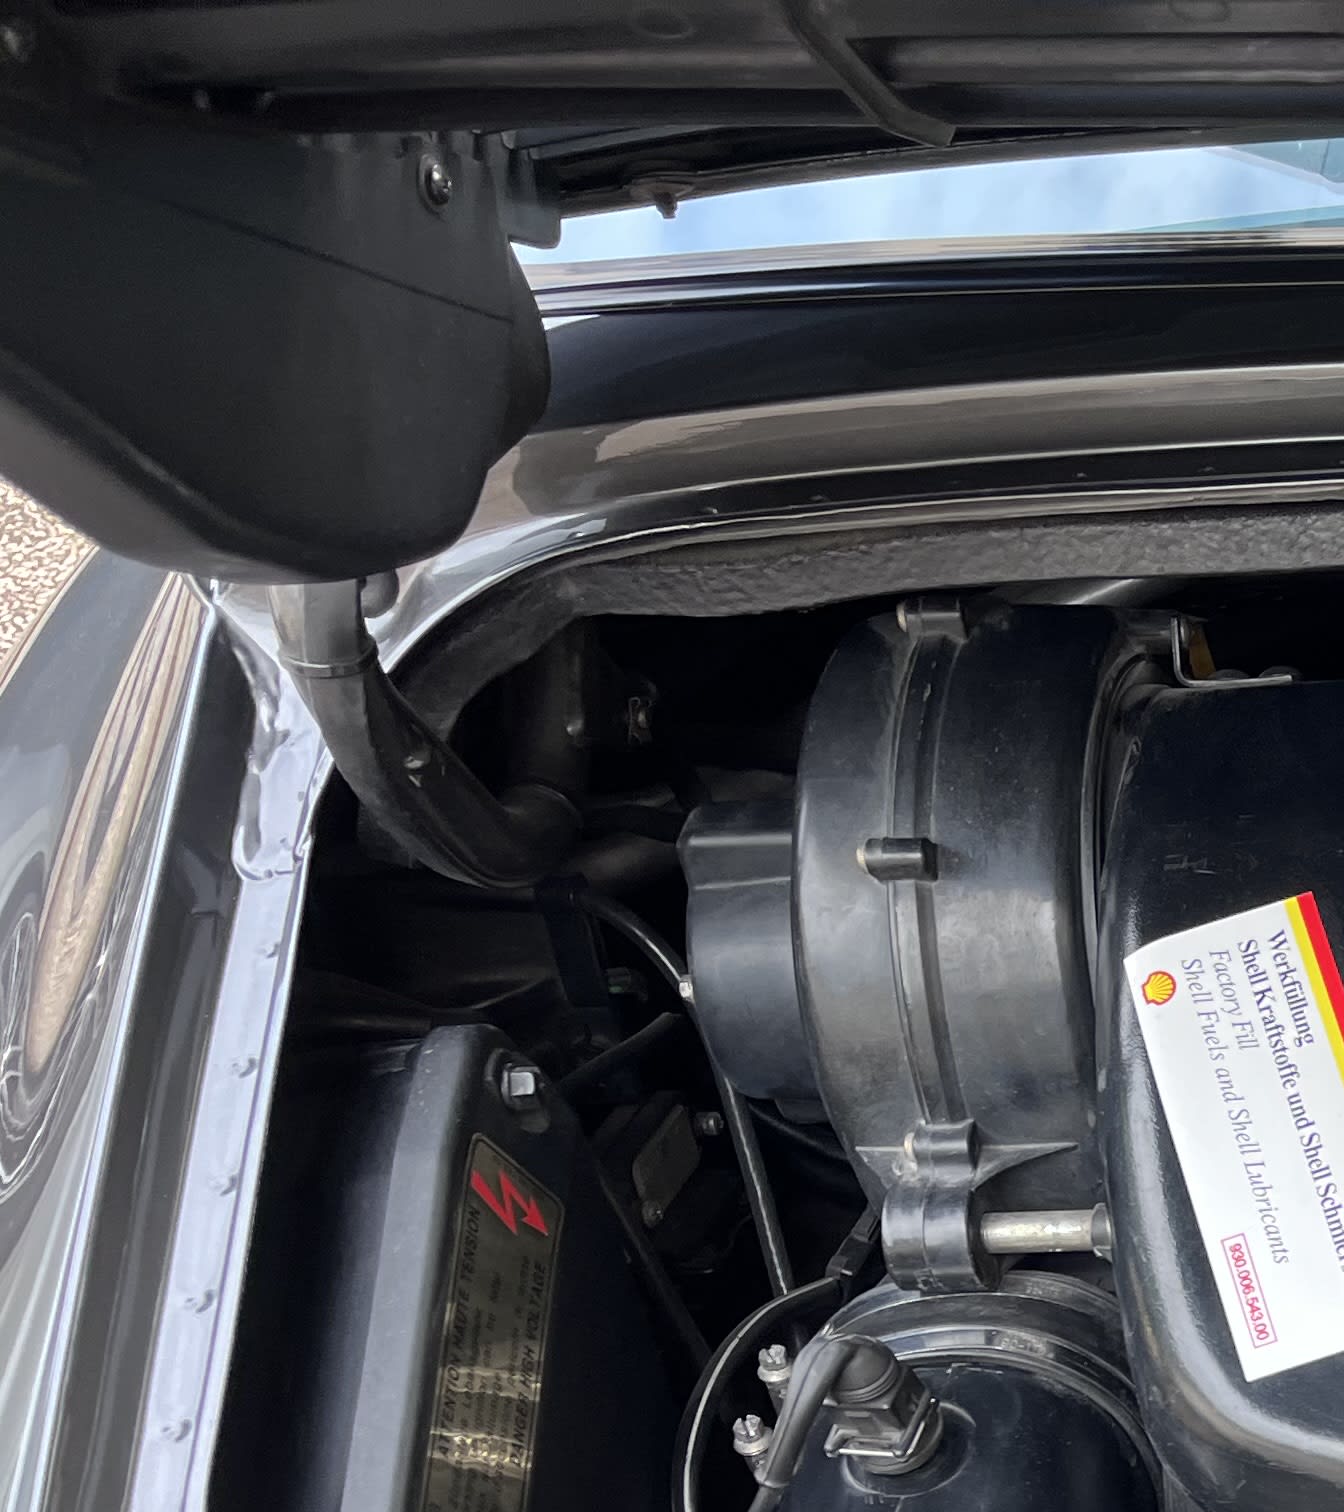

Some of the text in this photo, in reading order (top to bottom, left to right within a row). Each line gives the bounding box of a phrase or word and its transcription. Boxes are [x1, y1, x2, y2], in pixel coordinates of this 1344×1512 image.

[1209, 950, 1259, 1049] Factory Fill
[1238, 940, 1268, 985] Shell
[1269, 930, 1313, 1047] Werkfüllung
[1253, 986, 1300, 1088] Kraftstoffe
[1182, 959, 1288, 1263] Shell Fuels and Shell Lubricants
[1288, 1093, 1315, 1130] und
[1300, 1133, 1332, 1181] Shell
[460, 1203, 481, 1283] TENSION
[1230, 1244, 1268, 1340] 930.006.543.00
[520, 1344, 537, 1390] HIGH
